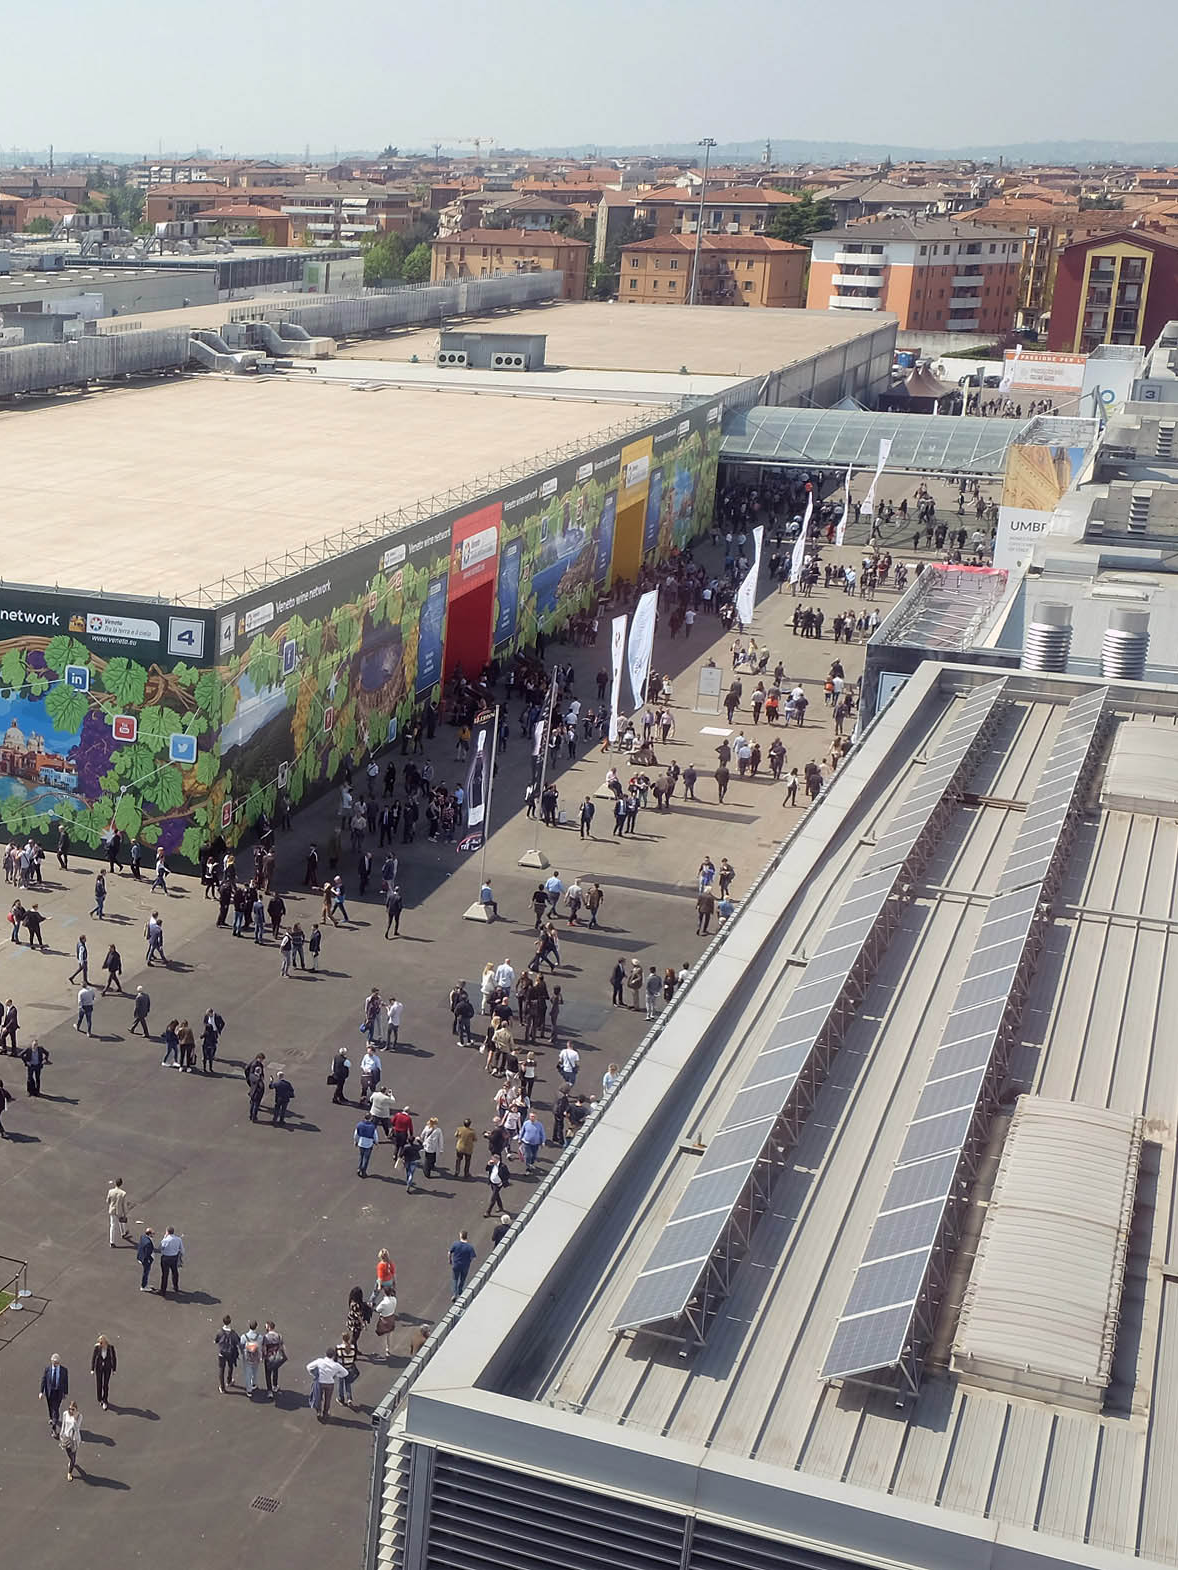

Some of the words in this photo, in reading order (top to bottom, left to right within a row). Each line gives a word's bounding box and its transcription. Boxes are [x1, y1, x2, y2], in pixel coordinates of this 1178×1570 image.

[1145, 390, 1156, 399] 3
[275, 597, 295, 614] Veneto
[296, 591, 309, 606] wine
[309, 579, 332, 600] network
[0, 608, 60, 626] network
[92, 635, 137, 646] www.veneto.eu
[177, 630, 194, 646] 4
[223, 625, 231, 641] 4
